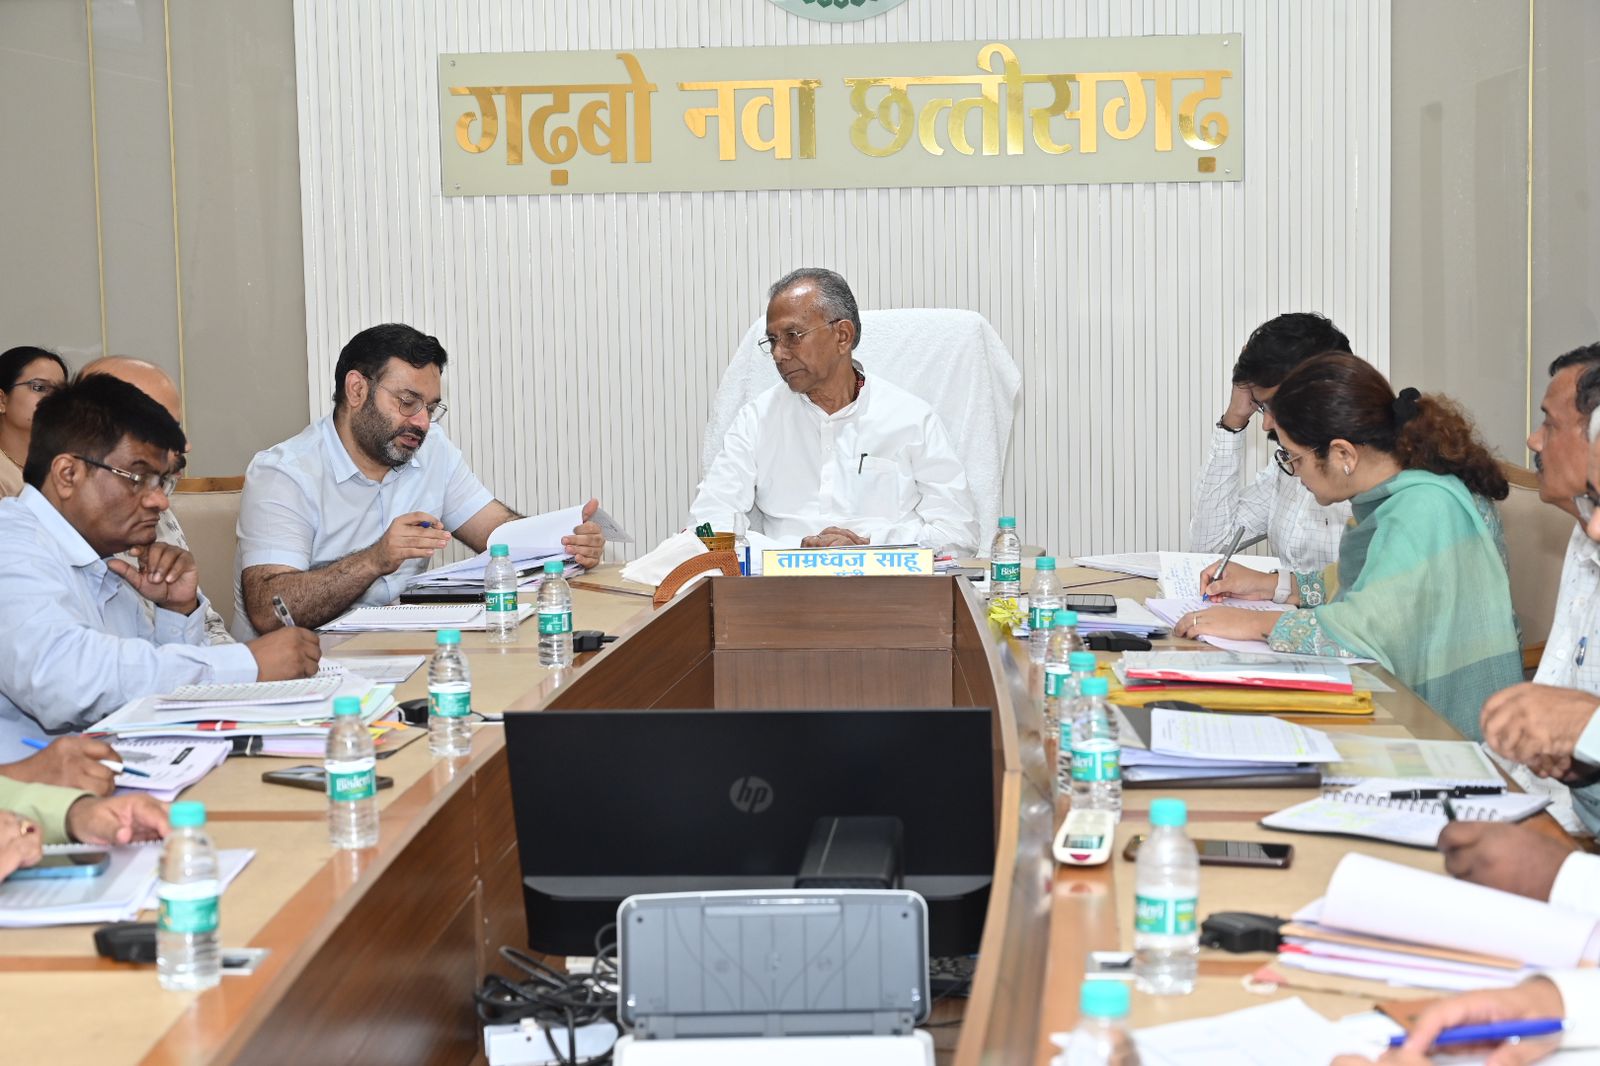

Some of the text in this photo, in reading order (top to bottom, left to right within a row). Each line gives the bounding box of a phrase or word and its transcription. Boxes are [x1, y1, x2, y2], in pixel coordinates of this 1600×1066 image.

[448, 43, 1233, 186] गढ़बो नवा छत्तीसगढ़
[776, 552, 922, 572] ताम्रध्वज साहू
